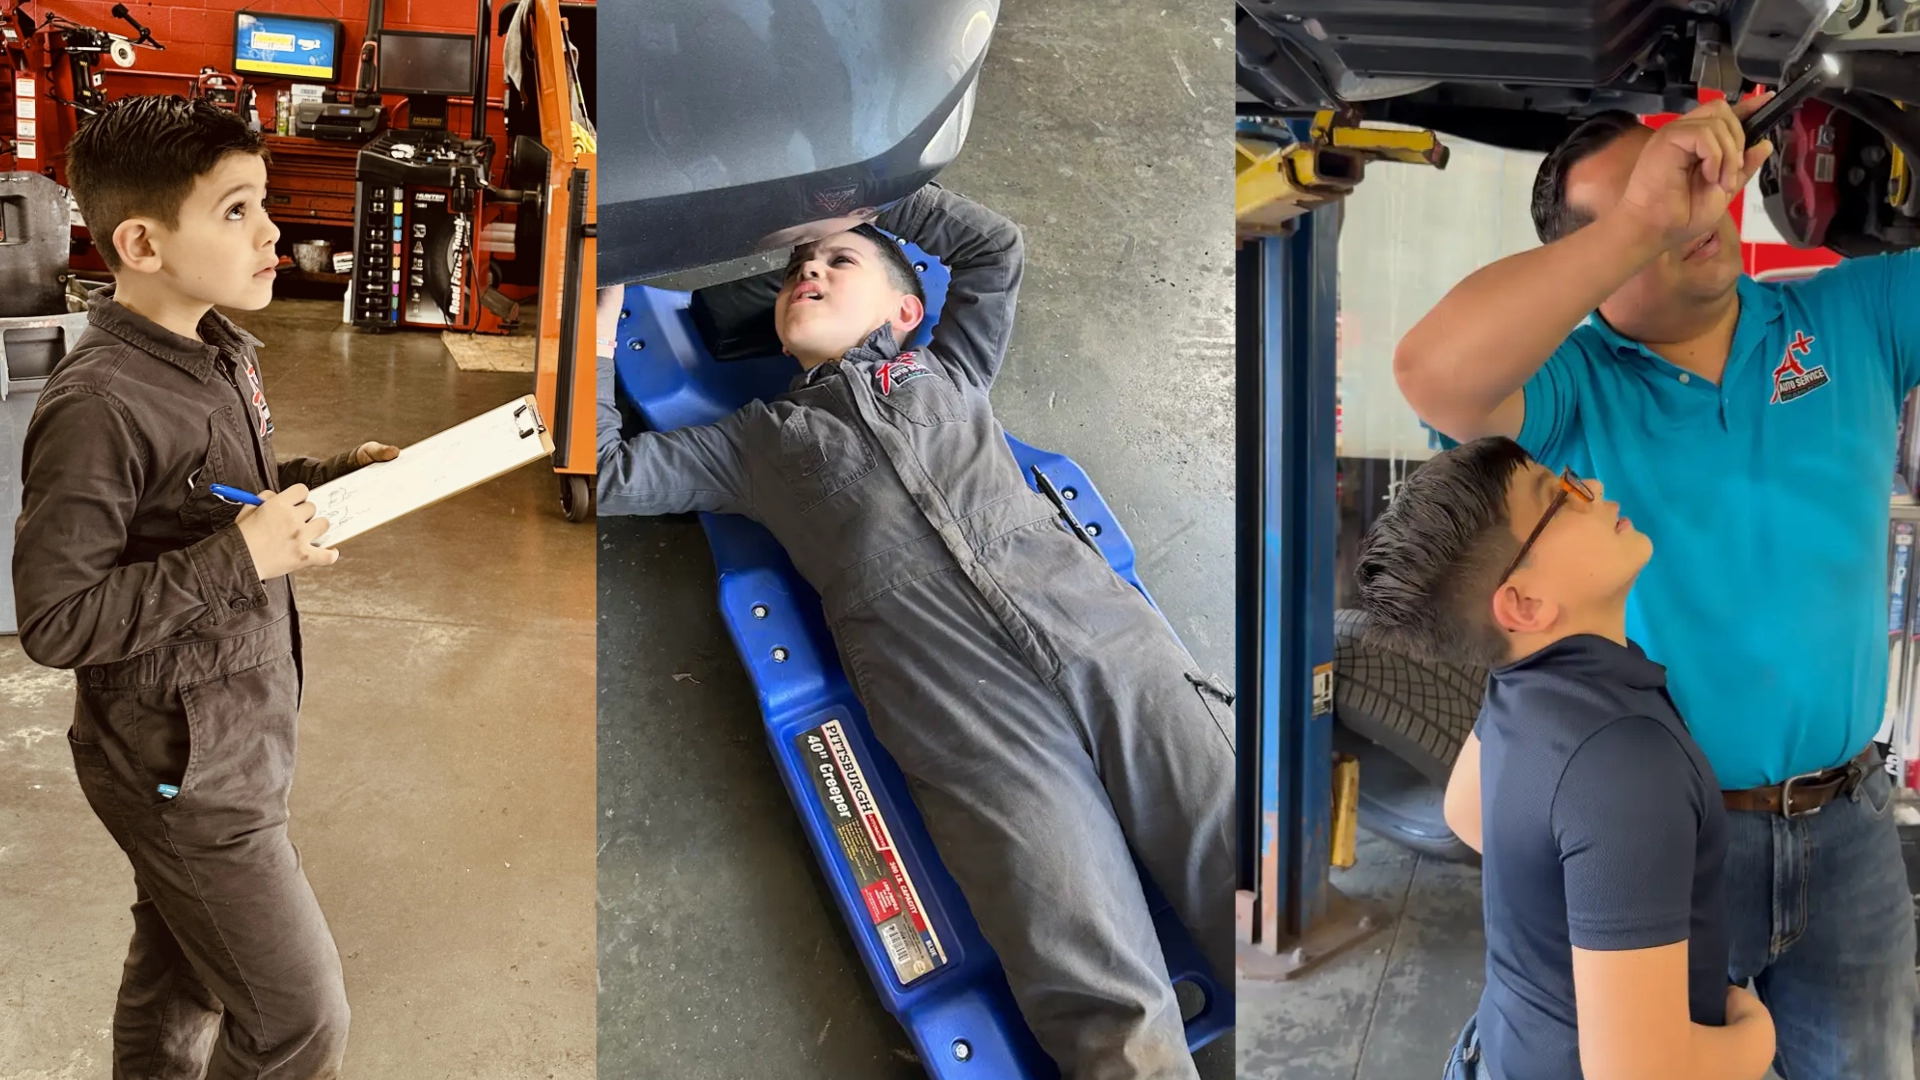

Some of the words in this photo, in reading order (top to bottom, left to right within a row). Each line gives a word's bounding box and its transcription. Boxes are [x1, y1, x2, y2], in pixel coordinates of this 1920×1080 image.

[452, 218, 465, 251] Touch
[451, 252, 463, 285] Force
[449, 286, 461, 315] Road
[891, 367, 909, 379] AUTO
[1779, 380, 1796, 393] AUTO
[1796, 369, 1825, 387] SERVICE
[807, 733, 829, 761] 40"
[818, 762, 852, 820] Creeper
[824, 724, 873, 815] PITTSBURGH
[866, 813, 887, 848] AUTOMOTIVE
[888, 860, 899, 875] 300
[899, 883, 918, 915] CAPACITY
[924, 939, 937, 957] BLUE
